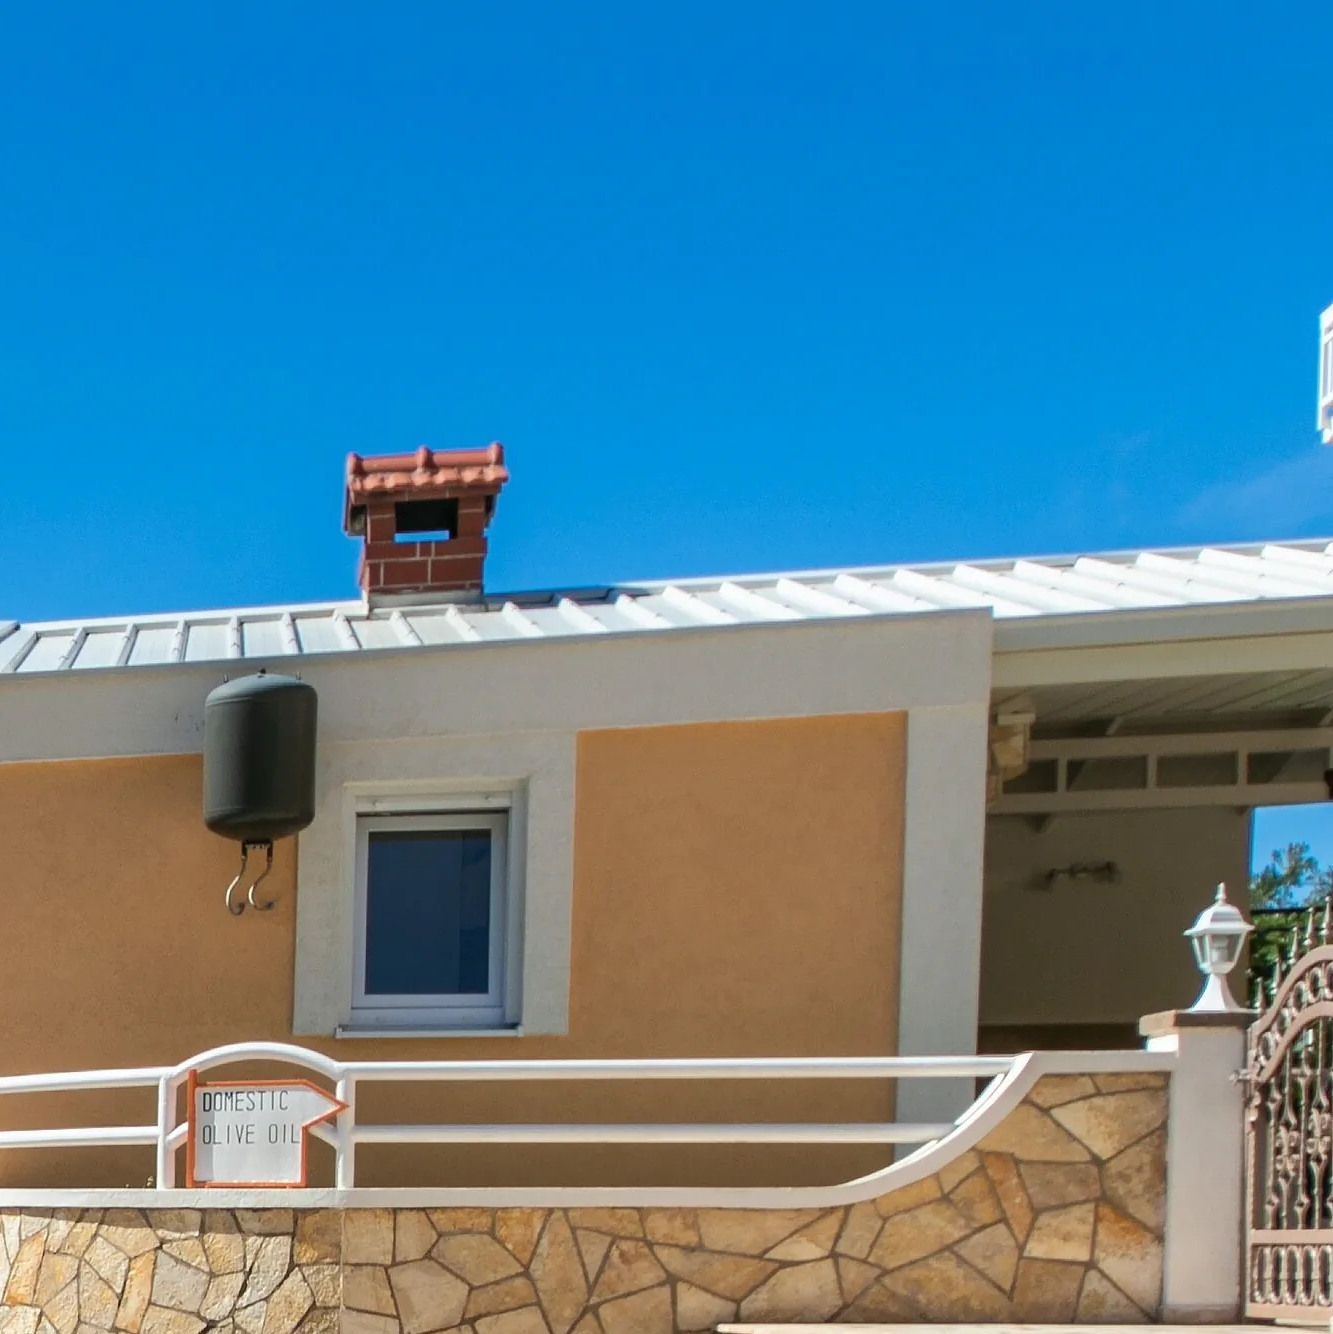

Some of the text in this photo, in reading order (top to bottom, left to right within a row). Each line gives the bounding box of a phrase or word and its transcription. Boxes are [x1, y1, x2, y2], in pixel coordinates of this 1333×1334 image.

[202, 1090, 289, 1113] DOMESTIC
[202, 1122, 301, 1145] OLIVE OIL
